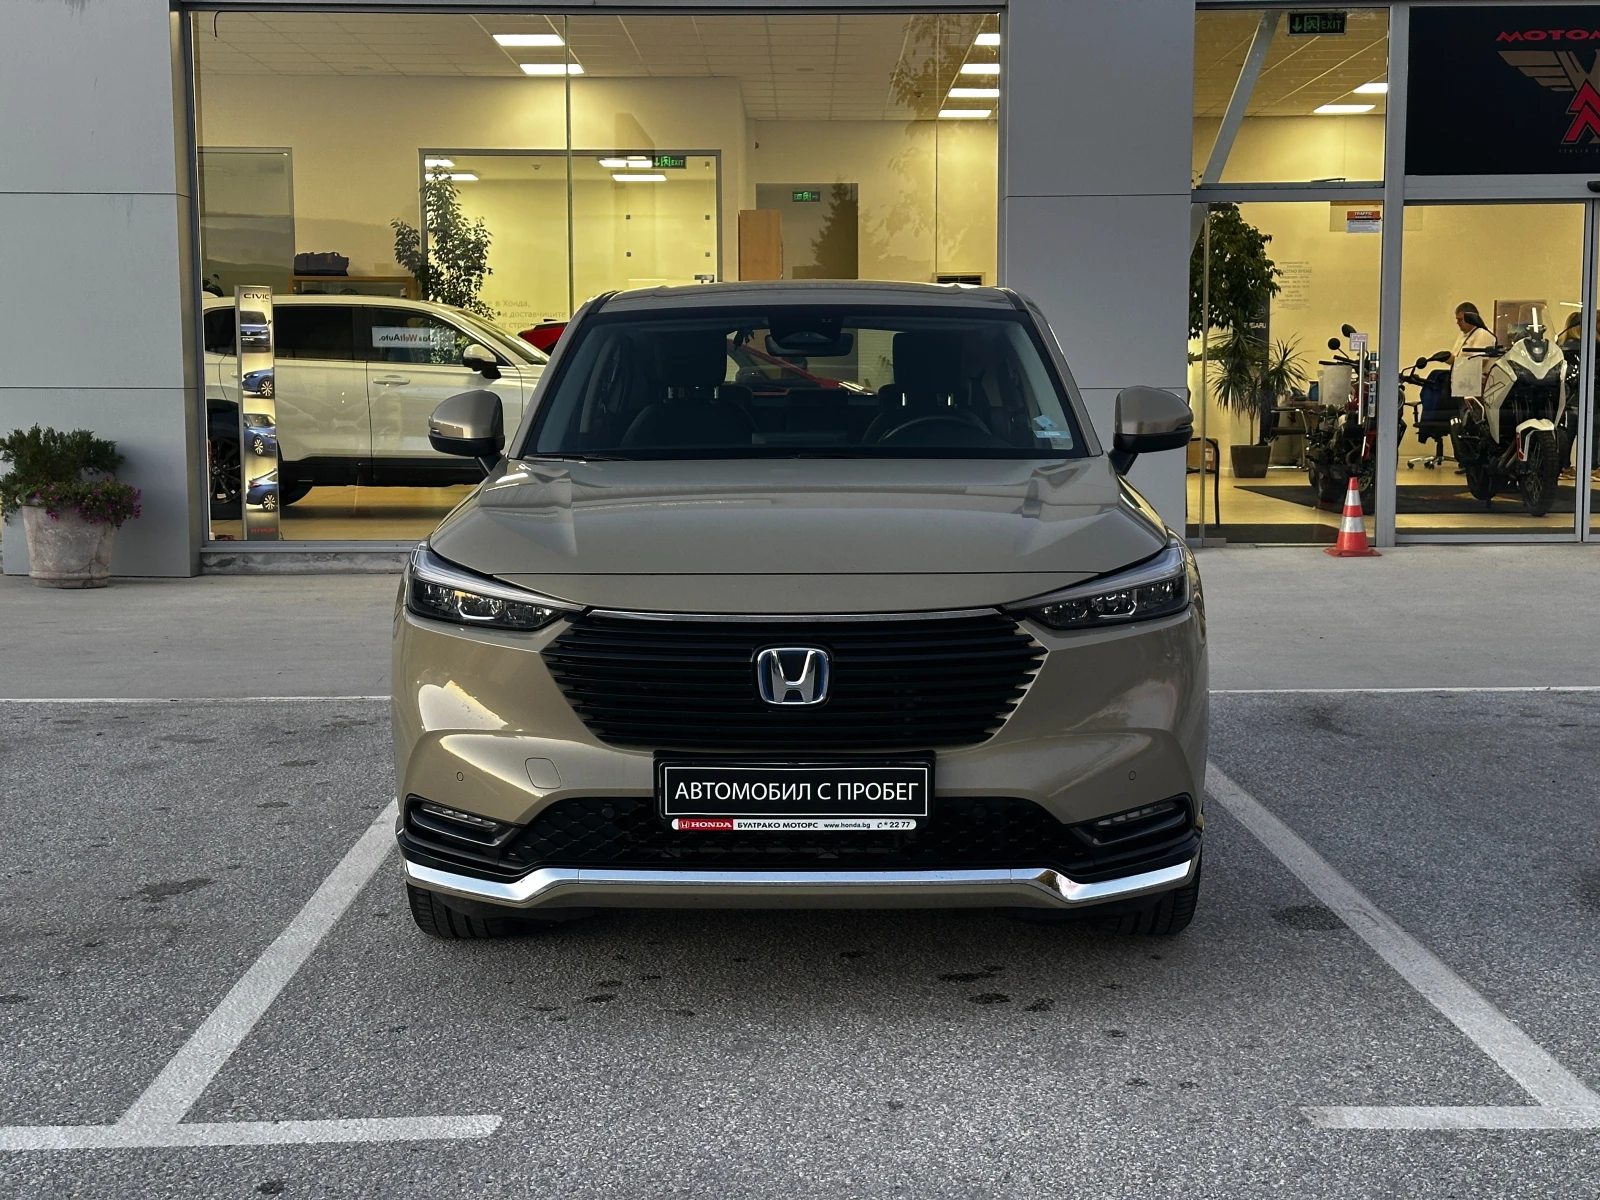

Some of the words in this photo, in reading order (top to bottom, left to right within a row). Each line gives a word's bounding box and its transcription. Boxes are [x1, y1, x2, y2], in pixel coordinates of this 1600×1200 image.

[1321, 20, 1341, 30] EXIT
[675, 781, 811, 801] АВТОМОБИЛ
[817, 782, 832, 801] С
[837, 782, 919, 801] ПРОБЕГ
[824, 821, 871, 829] www.honda.bg
